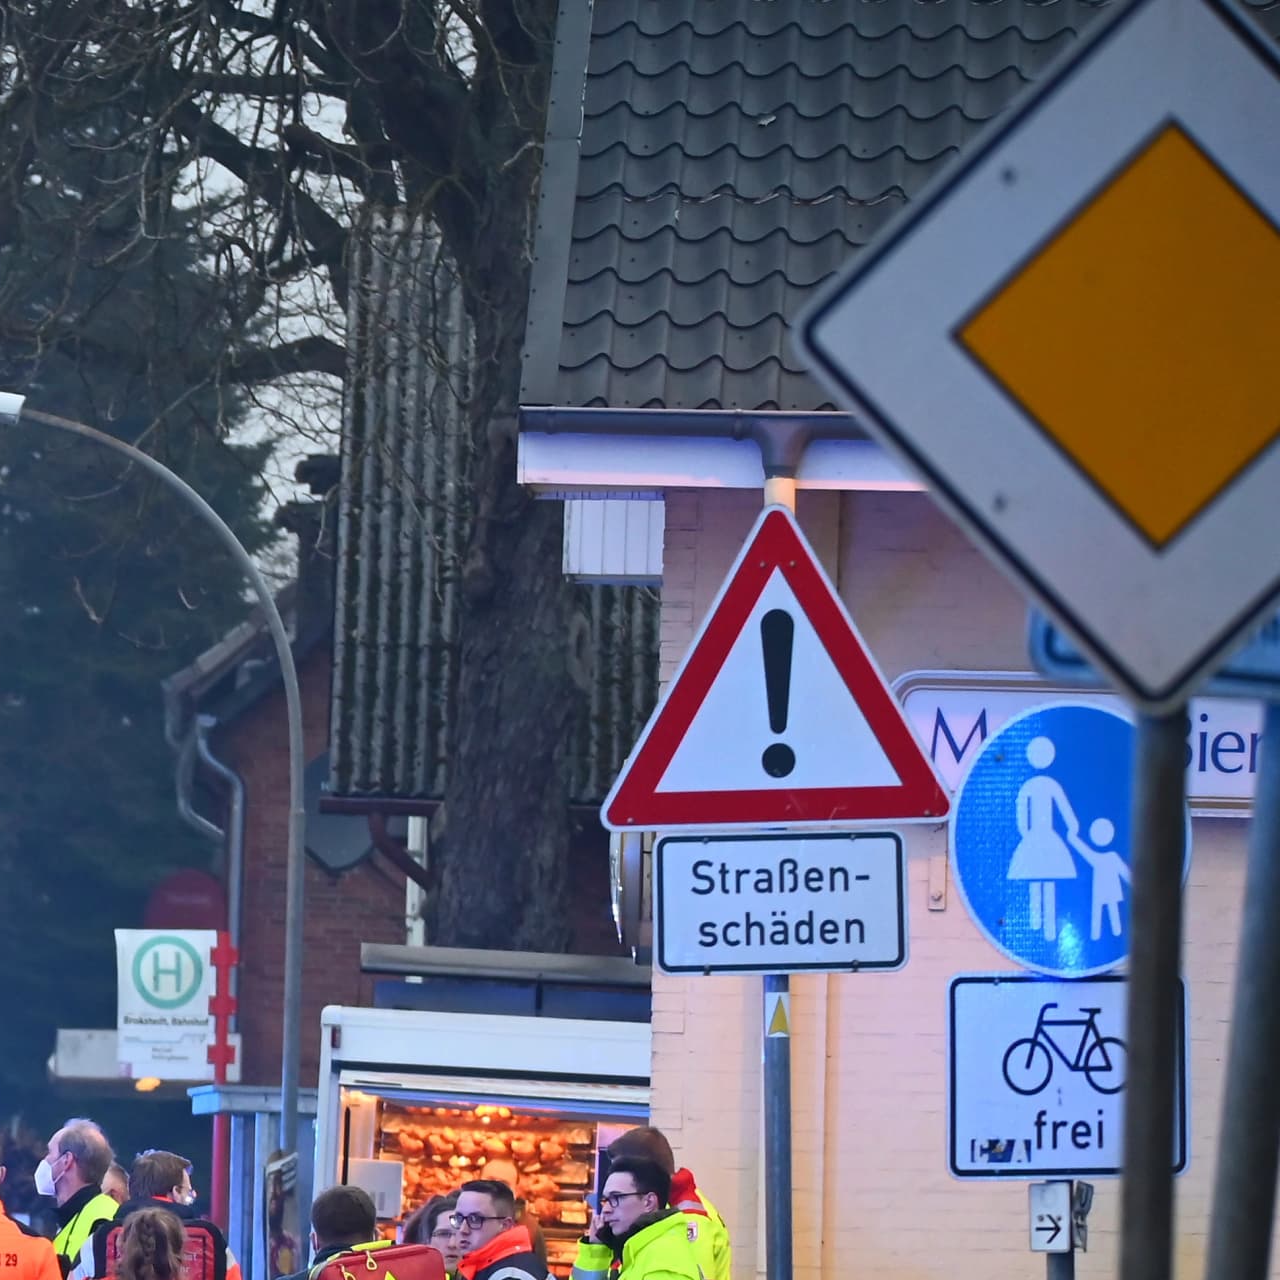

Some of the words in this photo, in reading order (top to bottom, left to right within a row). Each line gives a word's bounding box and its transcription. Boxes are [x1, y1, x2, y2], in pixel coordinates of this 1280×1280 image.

[1184, 713, 1262, 774] ier
[691, 858, 870, 895] Straßen-
[698, 911, 865, 947] schäden
[153, 951, 181, 992] H
[1034, 1110, 1104, 1150] frei
[5, 1253, 18, 1267] 29
